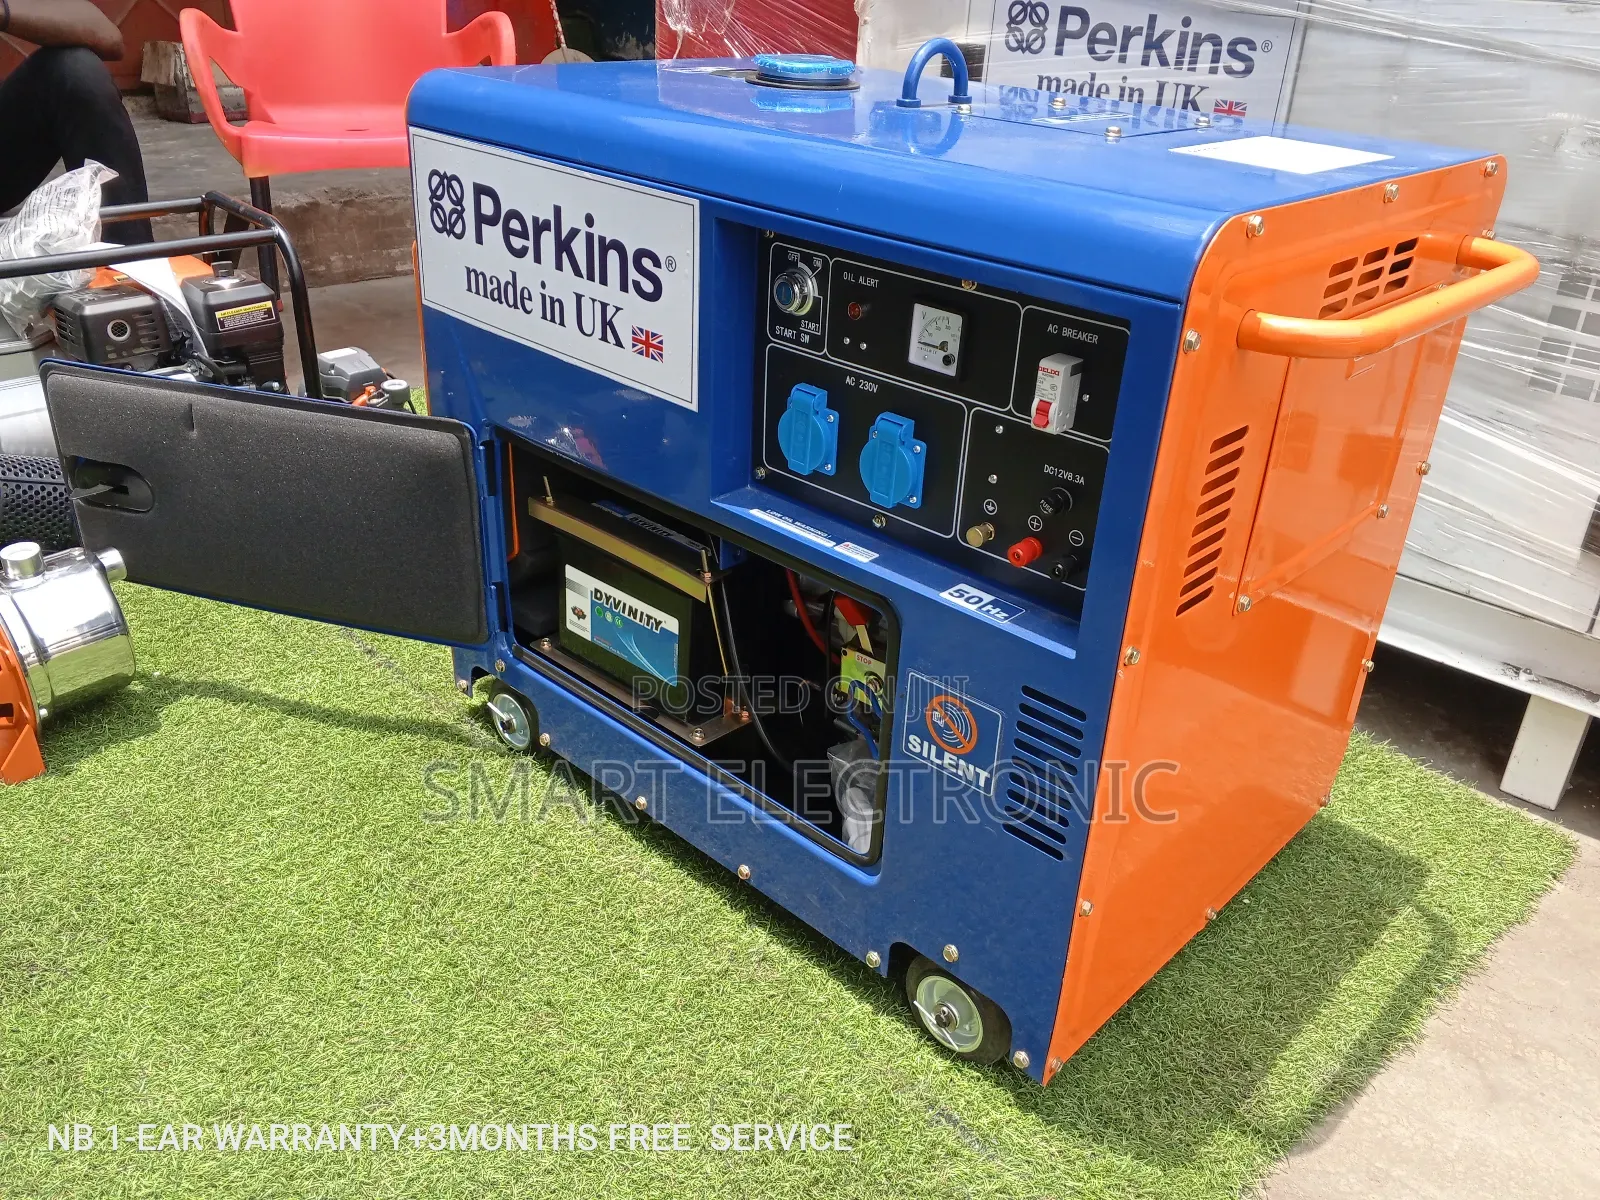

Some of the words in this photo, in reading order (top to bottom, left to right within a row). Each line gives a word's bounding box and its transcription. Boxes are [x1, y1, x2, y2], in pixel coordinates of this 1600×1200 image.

[1037, 72, 1111, 99] made
[1118, 76, 1145, 104] in
[1155, 80, 1210, 112] UK
[788, 252, 799, 262] OFF
[812, 259, 821, 267] ON
[843, 272, 855, 282] OIL
[858, 275, 879, 288] ALERT
[464, 265, 533, 315] made
[540, 280, 566, 328] in
[572, 291, 625, 350] UK
[800, 320, 820, 331] START
[1047, 323, 1058, 334] AC
[1062, 327, 1098, 344] BREAKER
[775, 326, 797, 340] START
[800, 333, 810, 344] SW
[845, 375, 856, 387] AC
[859, 379, 879, 393] 230V
[1043, 464, 1085, 486] DC12V8.3A
[1040, 499, 1054, 514] FUSE
[593, 587, 663, 634] DYVINITY
[948, 588, 984, 605] 50
[981, 604, 1010, 619] Hz
[856, 654, 872, 666] STOP
[907, 734, 991, 788] SILENT
